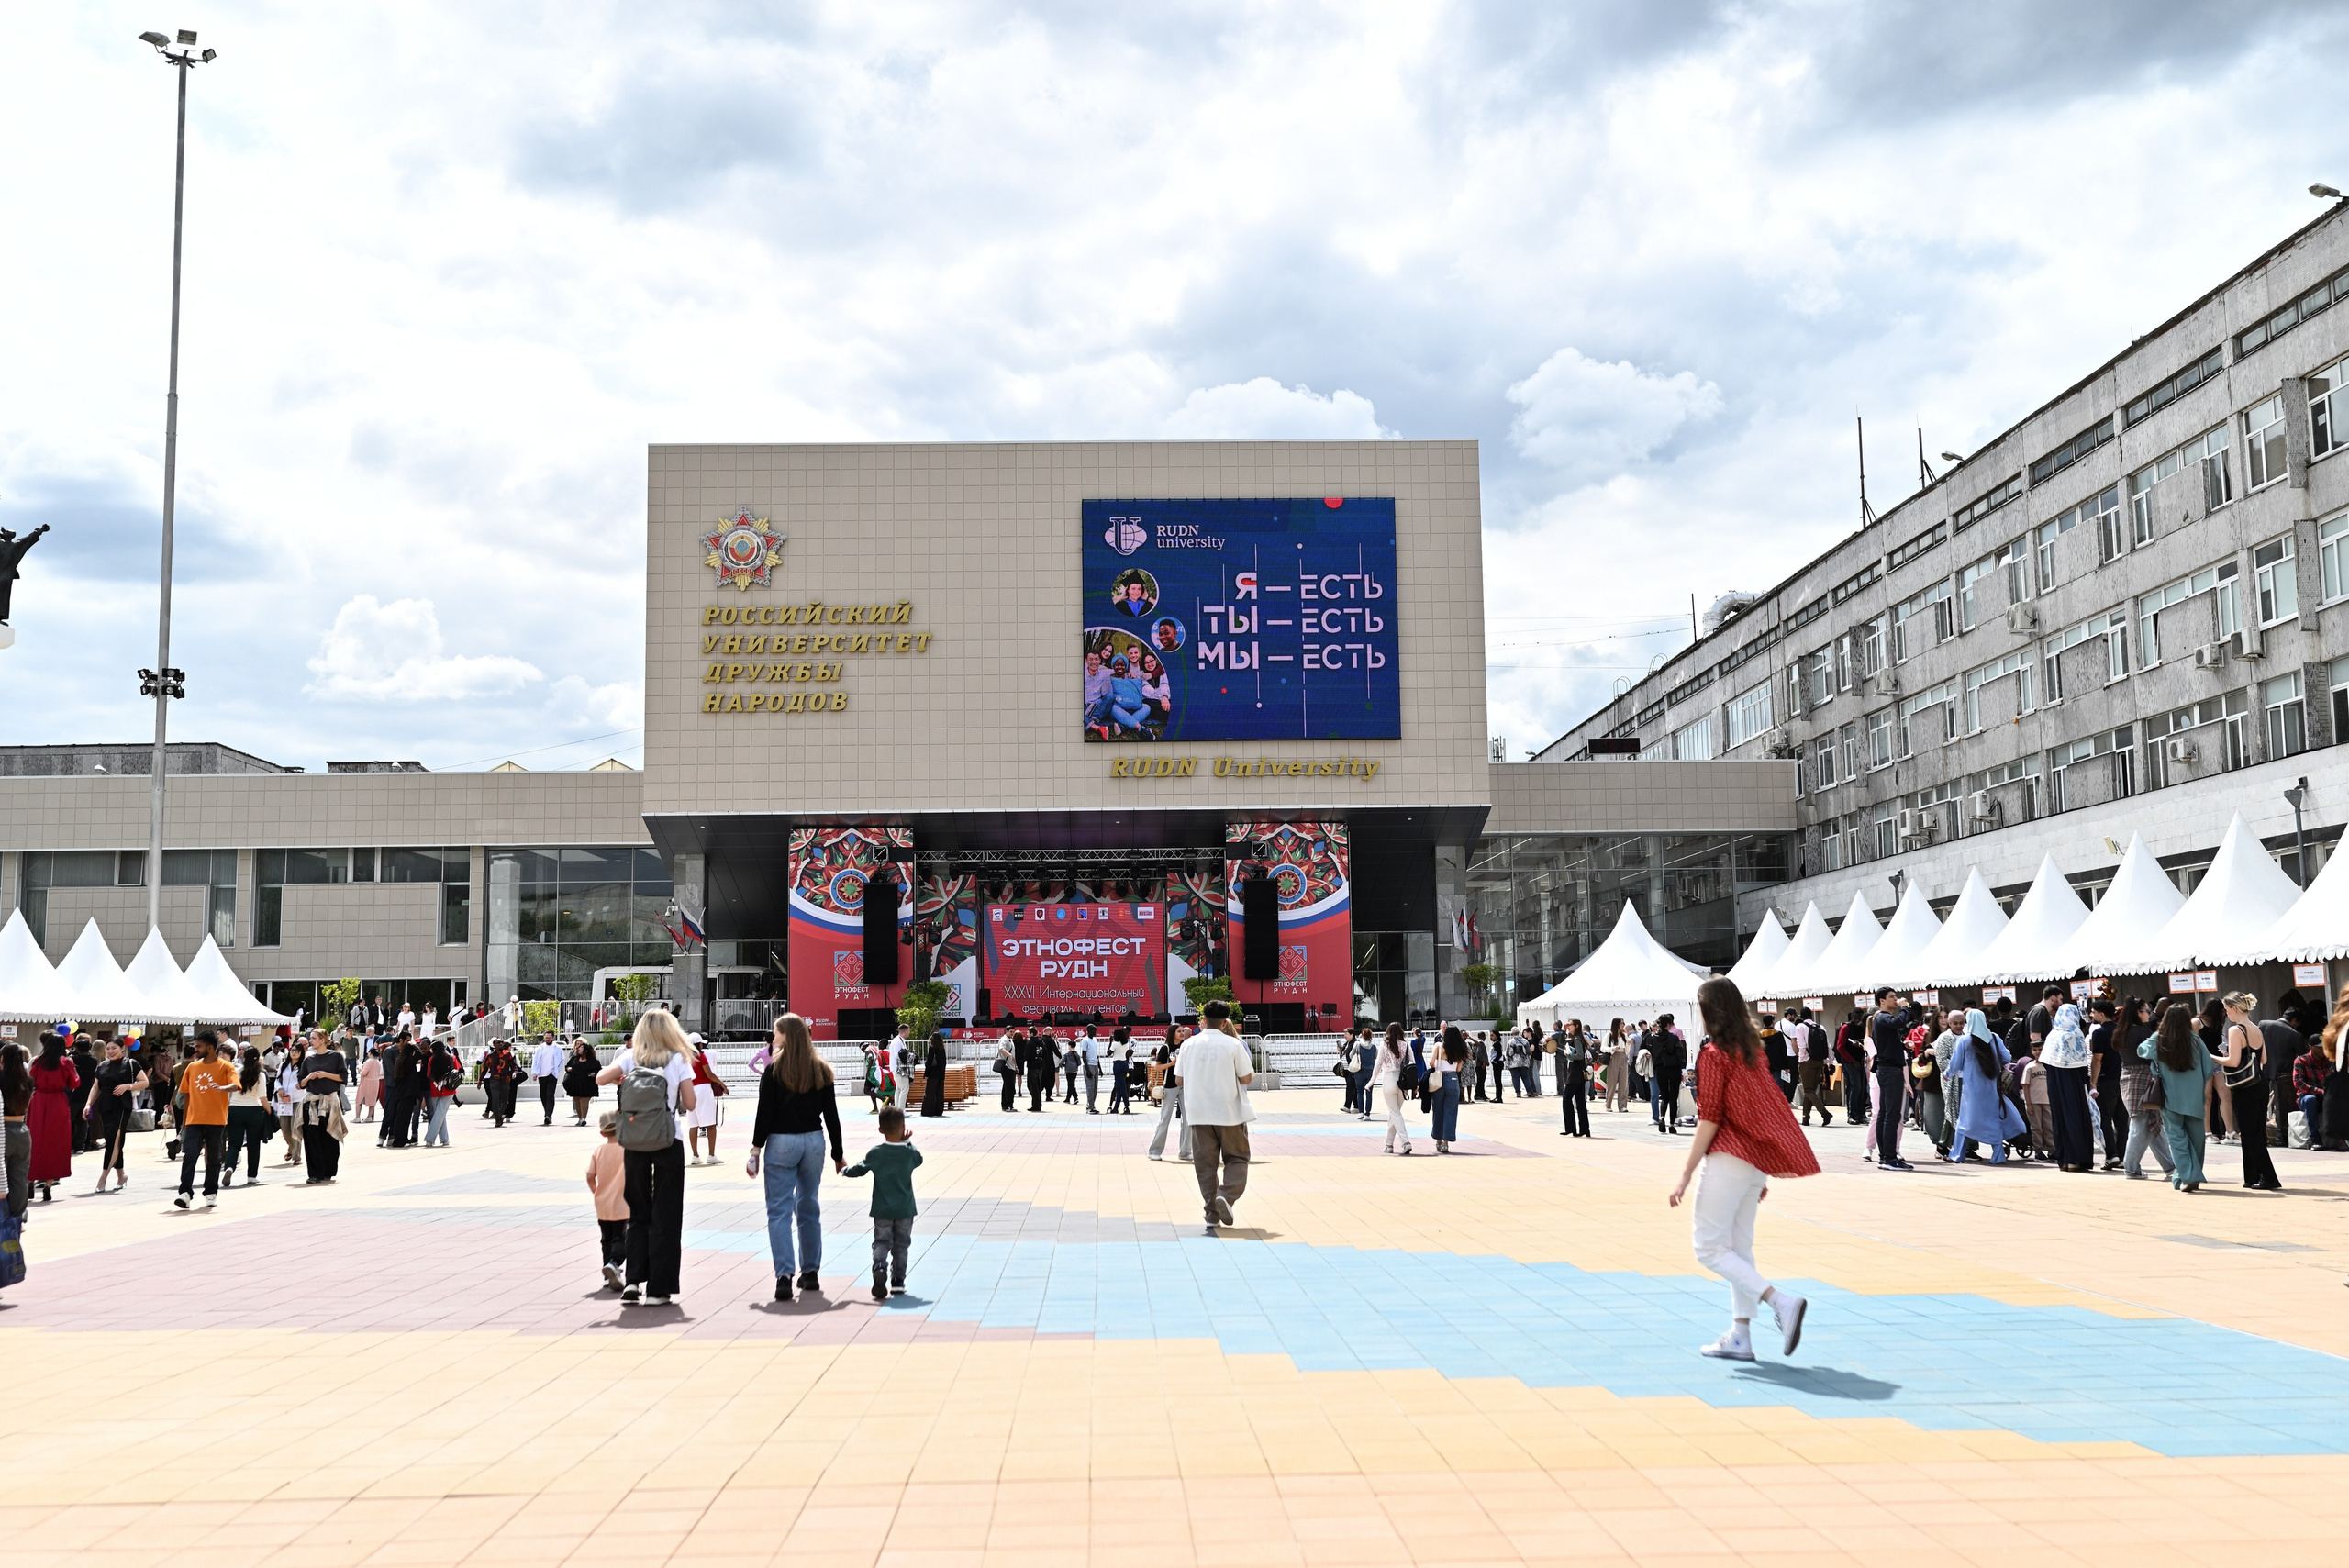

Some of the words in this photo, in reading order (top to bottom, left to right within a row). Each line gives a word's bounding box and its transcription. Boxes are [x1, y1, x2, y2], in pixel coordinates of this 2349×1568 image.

[1156, 525, 1199, 537] RUDN
[1156, 536, 1226, 550] university
[1235, 572, 1258, 600] Я
[1300, 573, 1384, 599] ЕСТЬ
[701, 600, 913, 626] РОССИЙСКИЙ
[1203, 606, 1258, 634] ТЫ
[1301, 607, 1384, 633] ЕСТЬ
[701, 632, 932, 653] УНИВЕРСИТЕТ
[1197, 641, 1259, 670] МЫ
[1302, 643, 1386, 670] ЕСТЬ
[702, 662, 843, 684] ДРУЖБЫ
[701, 692, 848, 713] НАРОДОВ
[1110, 757, 1198, 778] RUDN
[1213, 755, 1382, 781] University
[1001, 937, 1146, 957] ЭТНОФЕСТ
[1041, 960, 1108, 979] РУДН
[1004, 984, 1036, 1000] XXXVI
[1039, 985, 1145, 1002] Интернациональный
